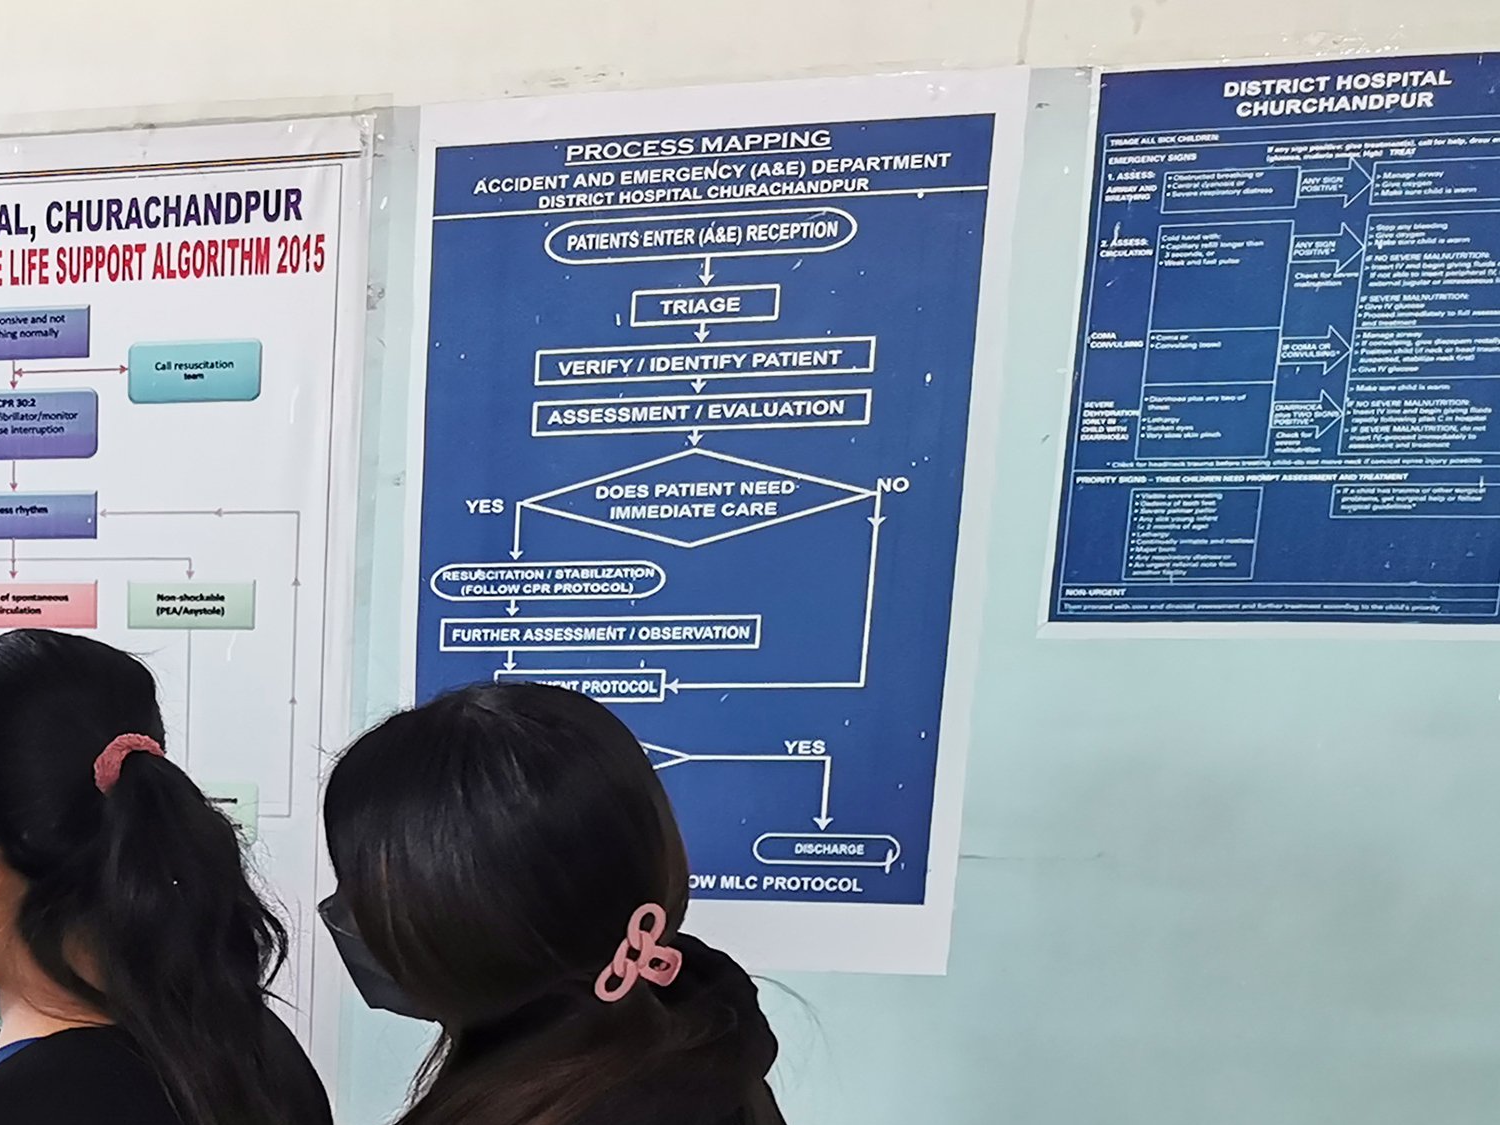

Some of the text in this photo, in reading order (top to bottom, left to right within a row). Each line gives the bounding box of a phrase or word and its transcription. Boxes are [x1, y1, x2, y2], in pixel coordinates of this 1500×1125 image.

[1223, 69, 1453, 99] DISTRICT HOSPITAL
[1235, 91, 1434, 118] CHURCHANDPUR
[566, 130, 831, 162] PROCESS MAPPING
[1108, 153, 1197, 165] EMERGENCY SIGNS
[473, 153, 952, 195] ACCIDENT AND EMERGENCY (A&E) DEPARTMENT
[538, 178, 870, 209] DISTRICT HOSPITAL CHURACHANDPUR
[46, 187, 303, 234] CHURACHANDPUR
[567, 221, 839, 251] PATIENTS ENTER (A&E) RECEPTION
[10, 247, 49, 286] LIFE
[56, 243, 147, 285] SUPPORT
[152, 236, 271, 280] ALGORITHM
[276, 233, 326, 275] 2015
[660, 297, 741, 315] TRIAGE
[30, 314, 47, 324] and
[49, 314, 66, 323] not
[19, 328, 60, 339] normally
[155, 360, 234, 371] Call resuscitation
[558, 358, 634, 377] VERIFY
[650, 354, 747, 372] IDENTIFY
[751, 349, 843, 368] PATIENT
[16, 398, 37, 408] 30:2
[547, 405, 690, 425] ASSESSMENT
[708, 400, 845, 420] EVALUATION
[11, 425, 65, 437] interruption
[595, 480, 795, 500] DOES PATIENT NEED
[876, 476, 910, 493] NO
[15, 505, 49, 516] rhythm
[465, 499, 504, 515] YES
[610, 501, 778, 520] IMMEDIATE CARE
[442, 568, 544, 582] RESUSCITATION
[554, 567, 655, 581] STABILIZATION
[460, 582, 634, 597] (FOLLOW CPR PROTOCOL)
[0, 593, 10, 602] of
[11, 594, 69, 604] spontaneous
[452, 627, 520, 643] FURTHER
[522, 626, 626, 642] ASSESSMENT
[638, 625, 750, 641] OBSERVATION
[581, 680, 658, 694] PROTOCOL
[784, 740, 826, 755] YES
[794, 843, 865, 856] DISCHARGE
[720, 875, 758, 890] MLC
[762, 876, 863, 893] PROTOCOL
